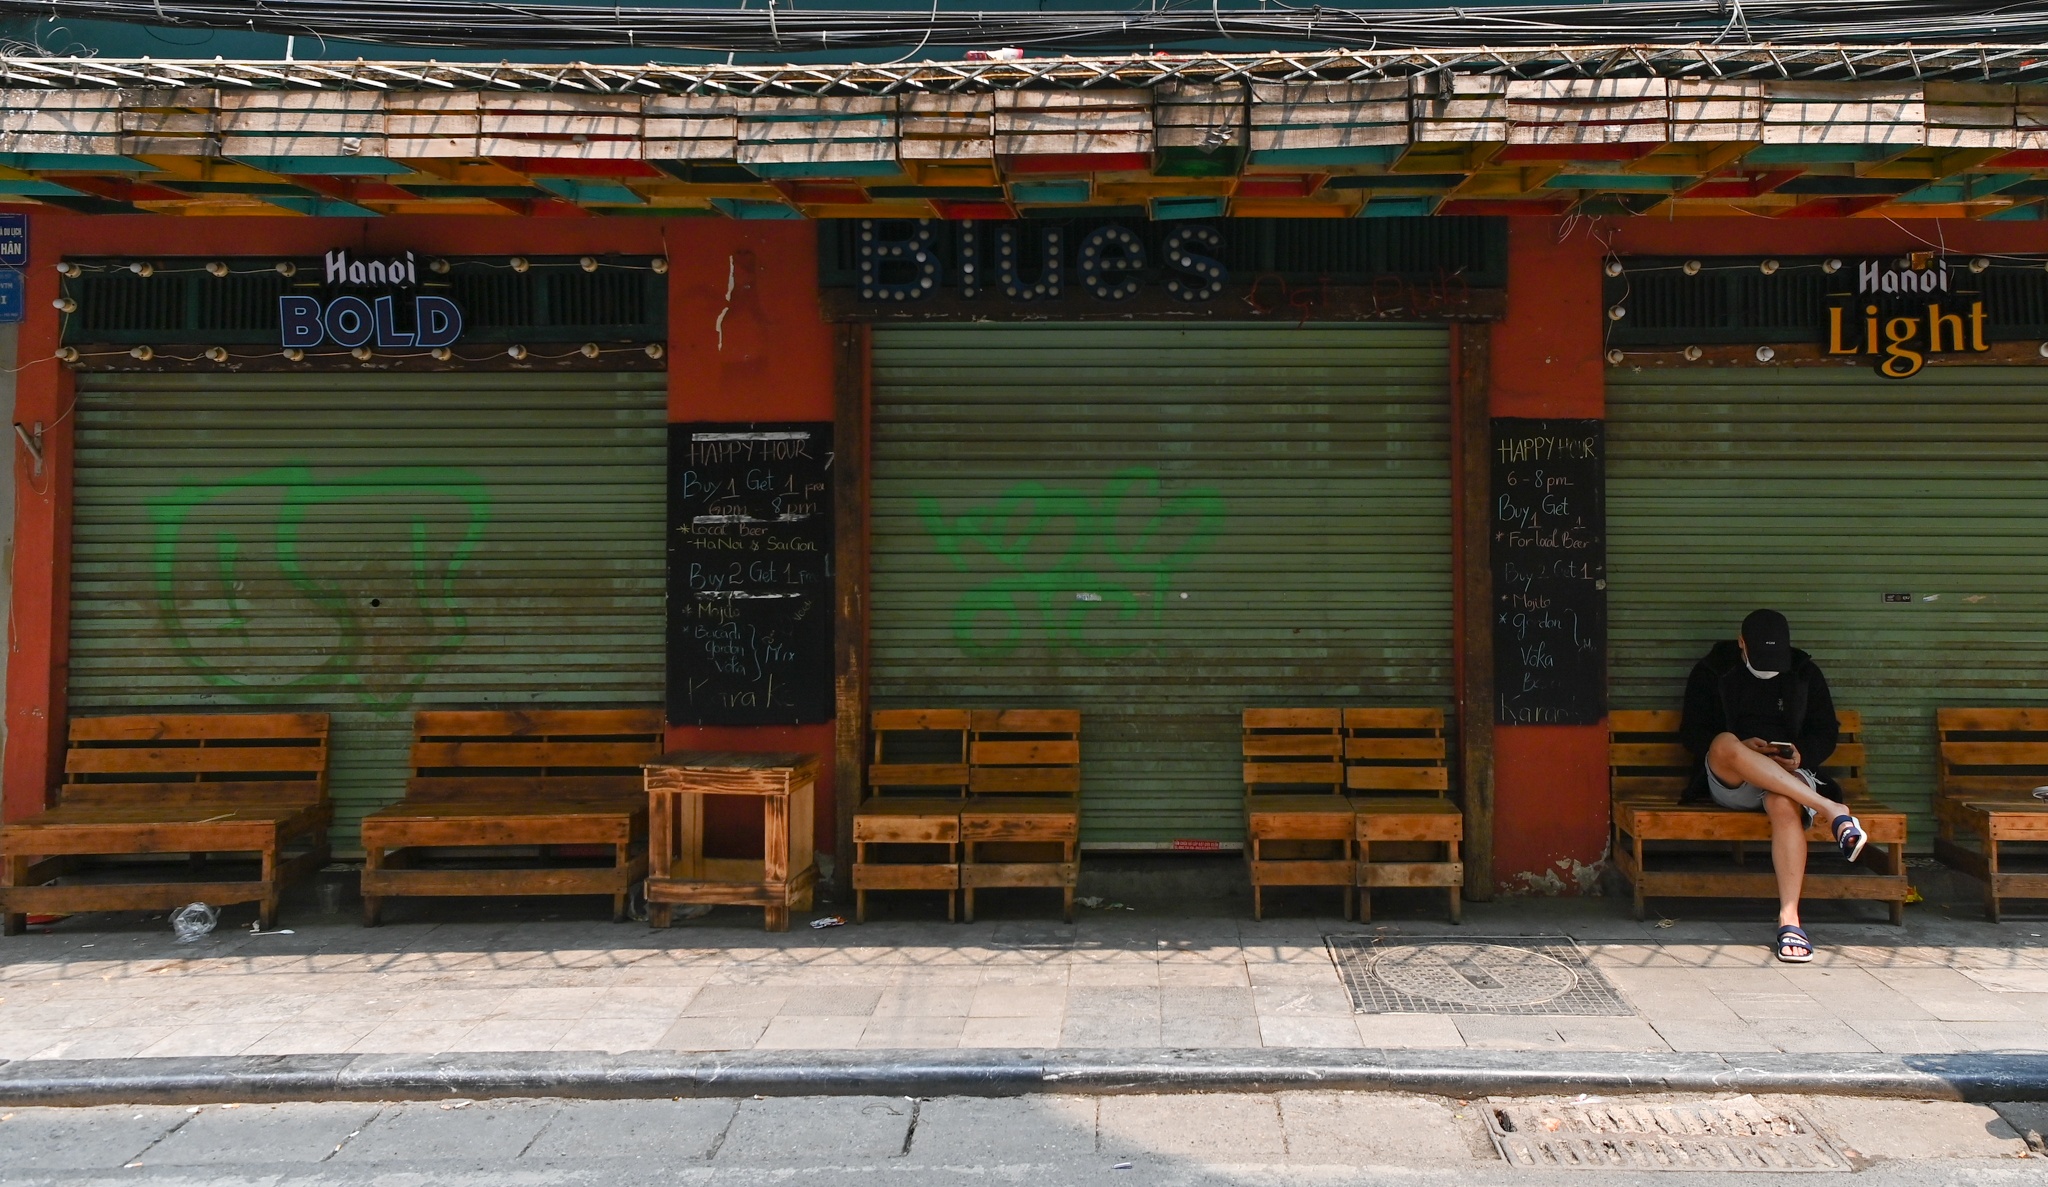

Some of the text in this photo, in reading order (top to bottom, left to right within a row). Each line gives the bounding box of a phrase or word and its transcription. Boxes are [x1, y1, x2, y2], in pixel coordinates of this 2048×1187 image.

[325, 250, 416, 285] Hanoi
[856, 217, 1229, 301] Blues
[1859, 259, 1948, 295] Hanoi
[279, 295, 462, 348] BOLD
[1828, 301, 1990, 378] Light
[686, 439, 813, 466] HAPPY HOUR
[1497, 437, 1555, 464] HAPPY
[683, 470, 722, 503] Buy
[721, 477, 741, 499] 1
[746, 468, 774, 491] Get
[779, 474, 799, 496] 1
[1507, 470, 1517, 486] 6
[1499, 493, 1586, 530] Buy 1 Get 1
[740, 522, 769, 536] Beer
[1509, 531, 1534, 547] For
[1562, 531, 1589, 549] Beer
[689, 562, 725, 591] Buy
[729, 561, 744, 585] 2
[750, 560, 777, 582] Get
[783, 562, 799, 584] 1
[1505, 562, 1533, 592] Buy
[1580, 562, 1594, 580] 1
